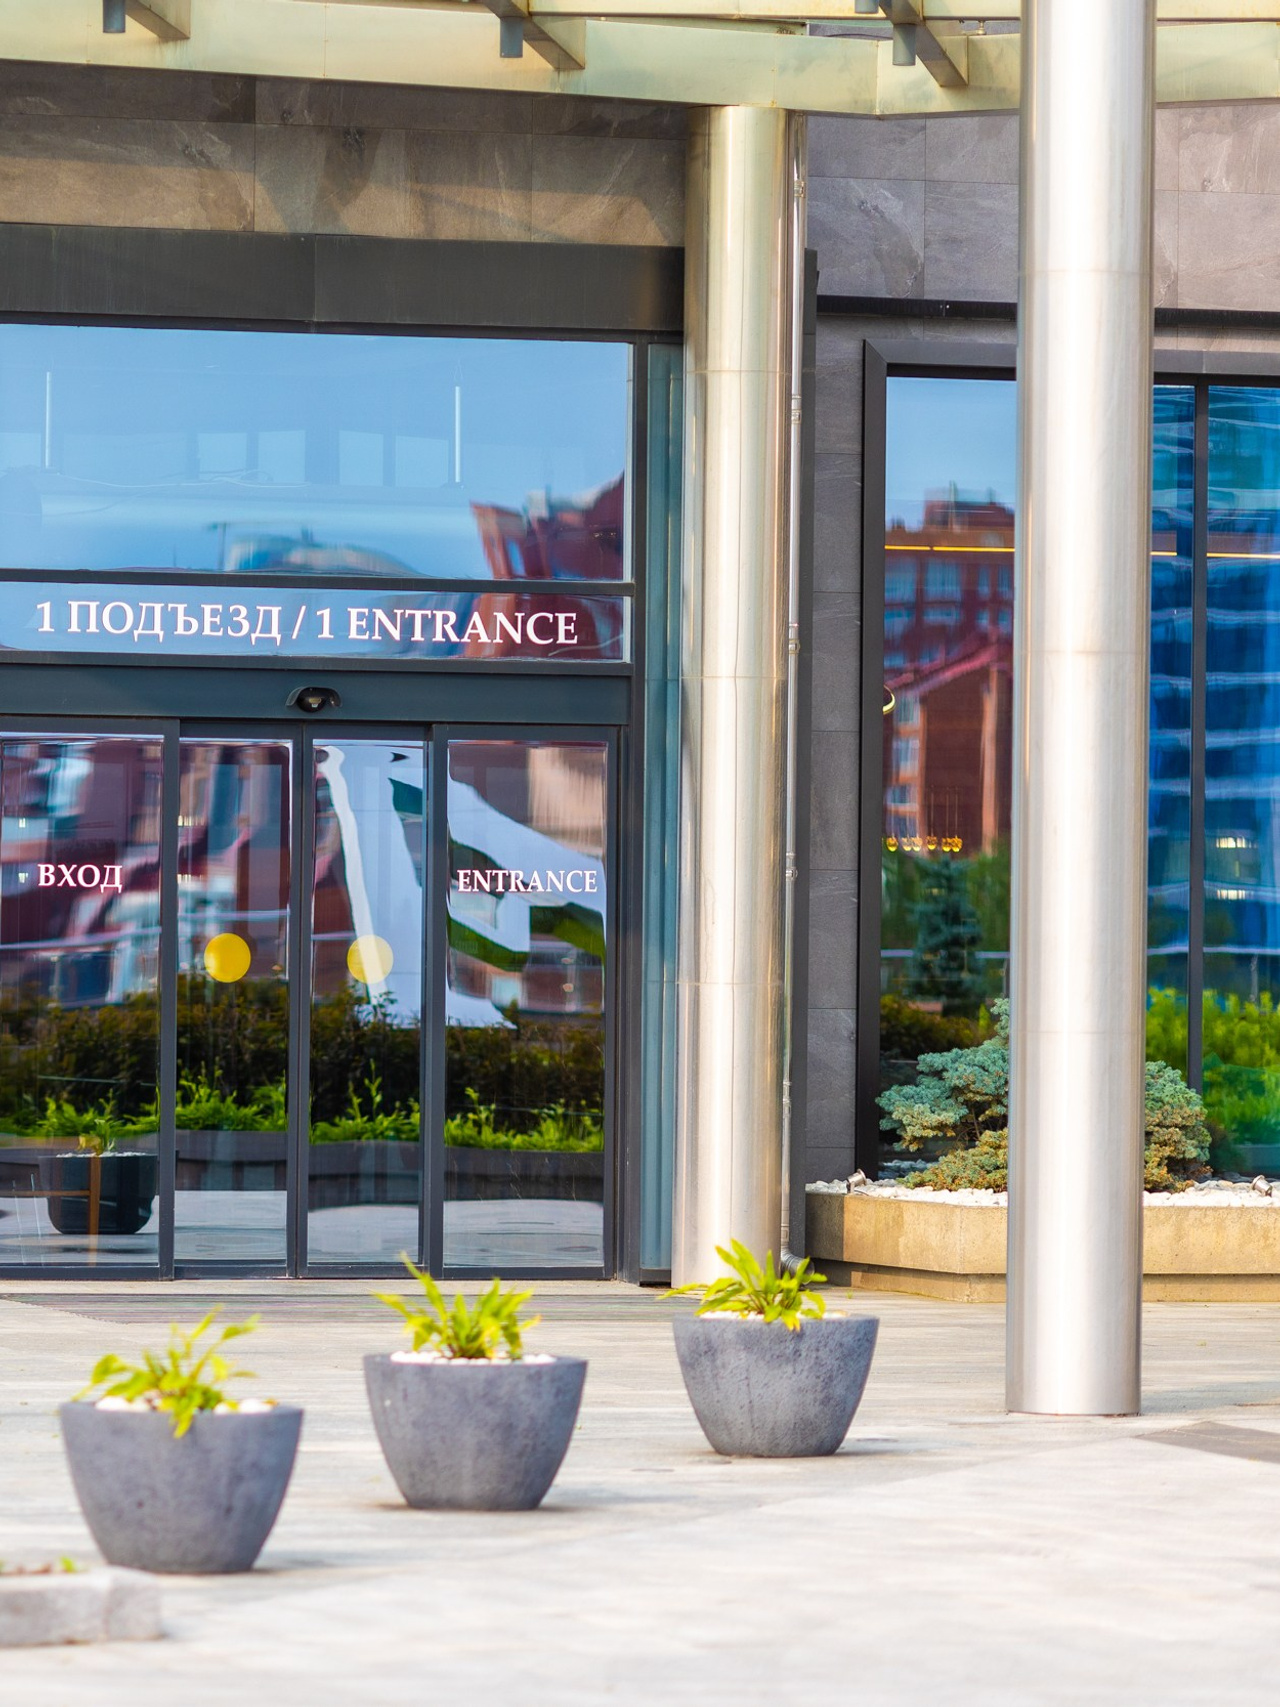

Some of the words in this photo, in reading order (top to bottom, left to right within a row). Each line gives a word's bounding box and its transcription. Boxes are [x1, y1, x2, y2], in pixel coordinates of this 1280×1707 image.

[36, 600, 55, 632] 1
[67, 601, 282, 646] ПОДЪЕЗД
[316, 607, 334, 639] 1
[347, 607, 578, 645] ENTRANCE
[37, 863, 123, 894] ВХОД
[456, 869, 598, 893] ENTRANCE
